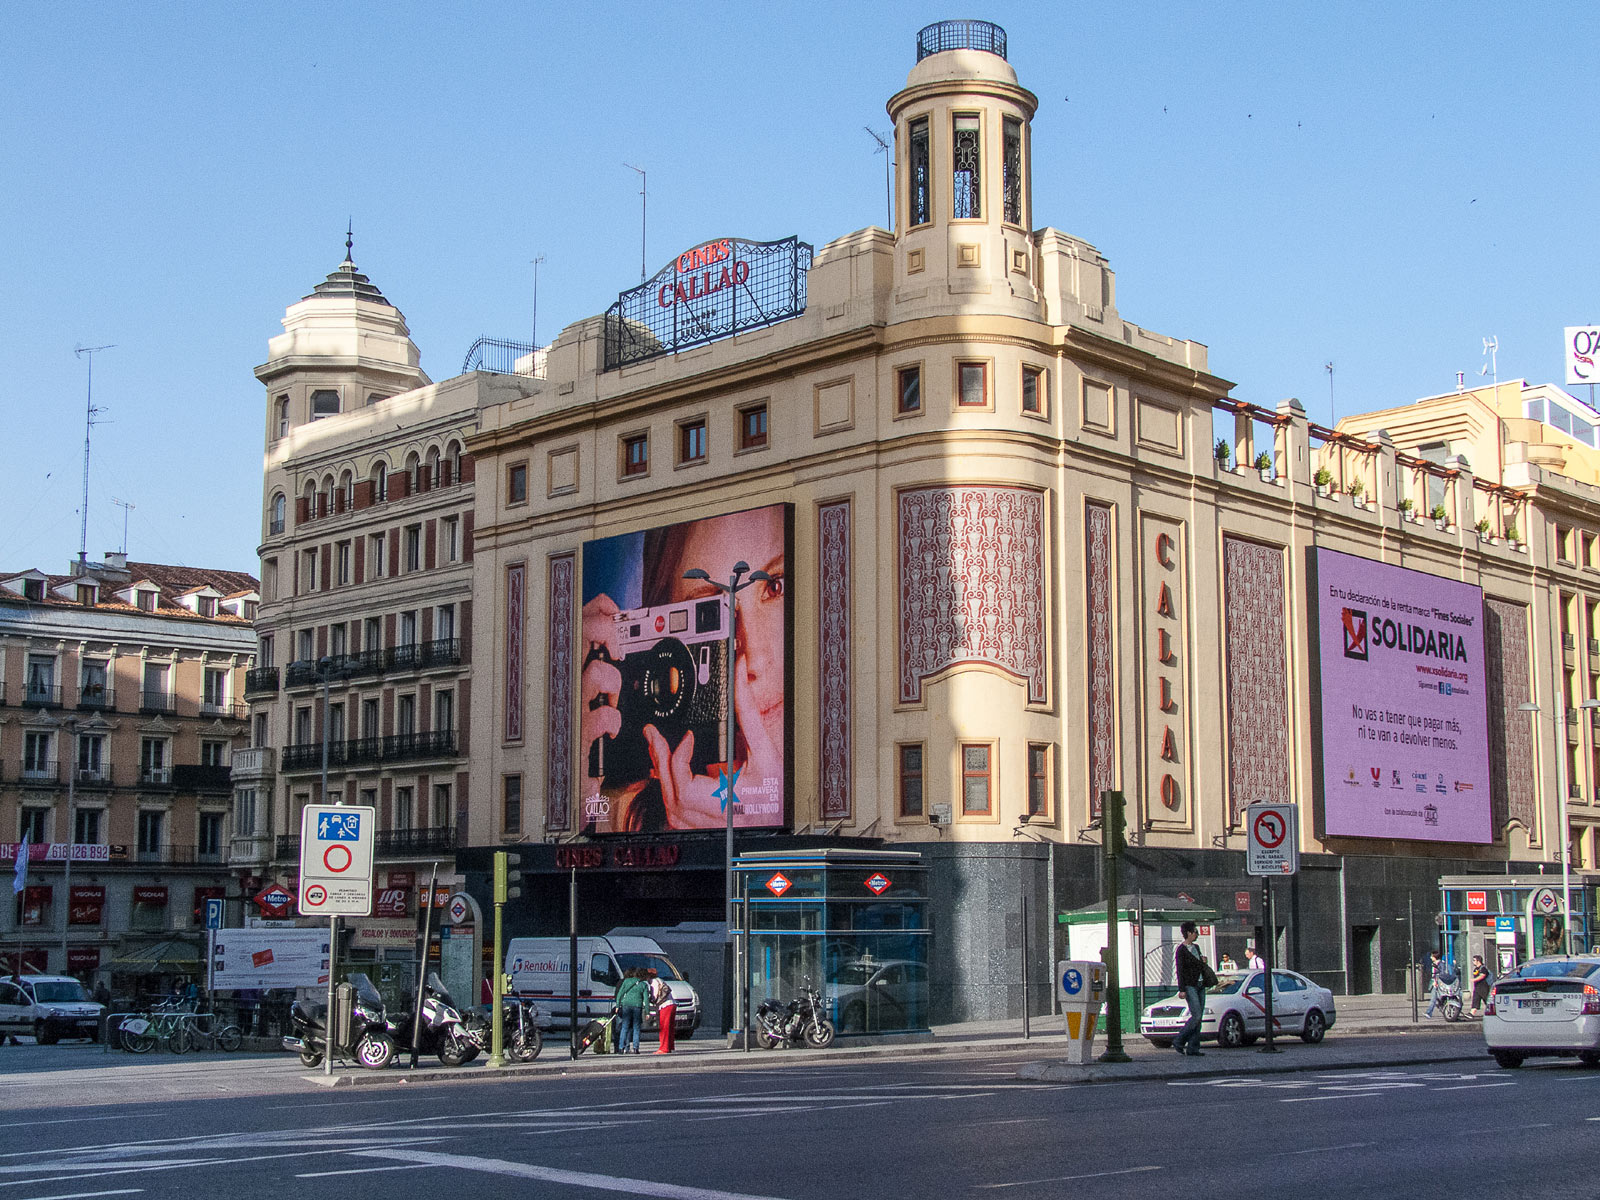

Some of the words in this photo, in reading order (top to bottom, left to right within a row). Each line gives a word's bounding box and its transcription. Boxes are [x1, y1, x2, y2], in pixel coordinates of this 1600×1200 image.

[676, 239, 730, 273] CINES
[658, 260, 749, 308] CALLAO
[1329, 585, 1338, 597] En
[1339, 589, 1347, 599] tu
[1347, 589, 1380, 607] declaración
[1381, 598, 1390, 608] de
[1390, 598, 1396, 610] la
[1397, 602, 1412, 613] renta
[1413, 606, 1430, 617] marca
[1372, 616, 1467, 663] SOLIDARIA
[1416, 665, 1468, 684] www.xsolidaria.org
[1352, 704, 1363, 719] No
[1365, 709, 1377, 721] vas
[1379, 711, 1384, 721] a
[1385, 710, 1406, 725] tener
[1407, 715, 1421, 729] que
[1423, 717, 1443, 732] pagar
[1445, 718, 1461, 735] más,
[1358, 725, 1366, 738] ni
[1368, 726, 1376, 740] te
[1377, 730, 1391, 742] van
[1393, 731, 1398, 742] a
[1400, 730, 1431, 746] devolver
[1432, 737, 1458, 750] menos.
[762, 778, 778, 786] ESTA
[741, 786, 778, 796] PRIMAVERA
[769, 793, 778, 801] EN
[586, 802, 609, 815] CALLAO
[0, 845, 13, 859] DE
[52, 846, 67, 858] 616
[71, 846, 87, 858] 126
[90, 846, 107, 858] 892
[556, 847, 601, 867] CINES
[613, 844, 678, 867] CALLAO
[267, 894, 287, 902] Metro
[362, 929, 381, 939] REGALOS
[384, 929, 389, 938] Y
[524, 960, 558, 971] Rentokil
